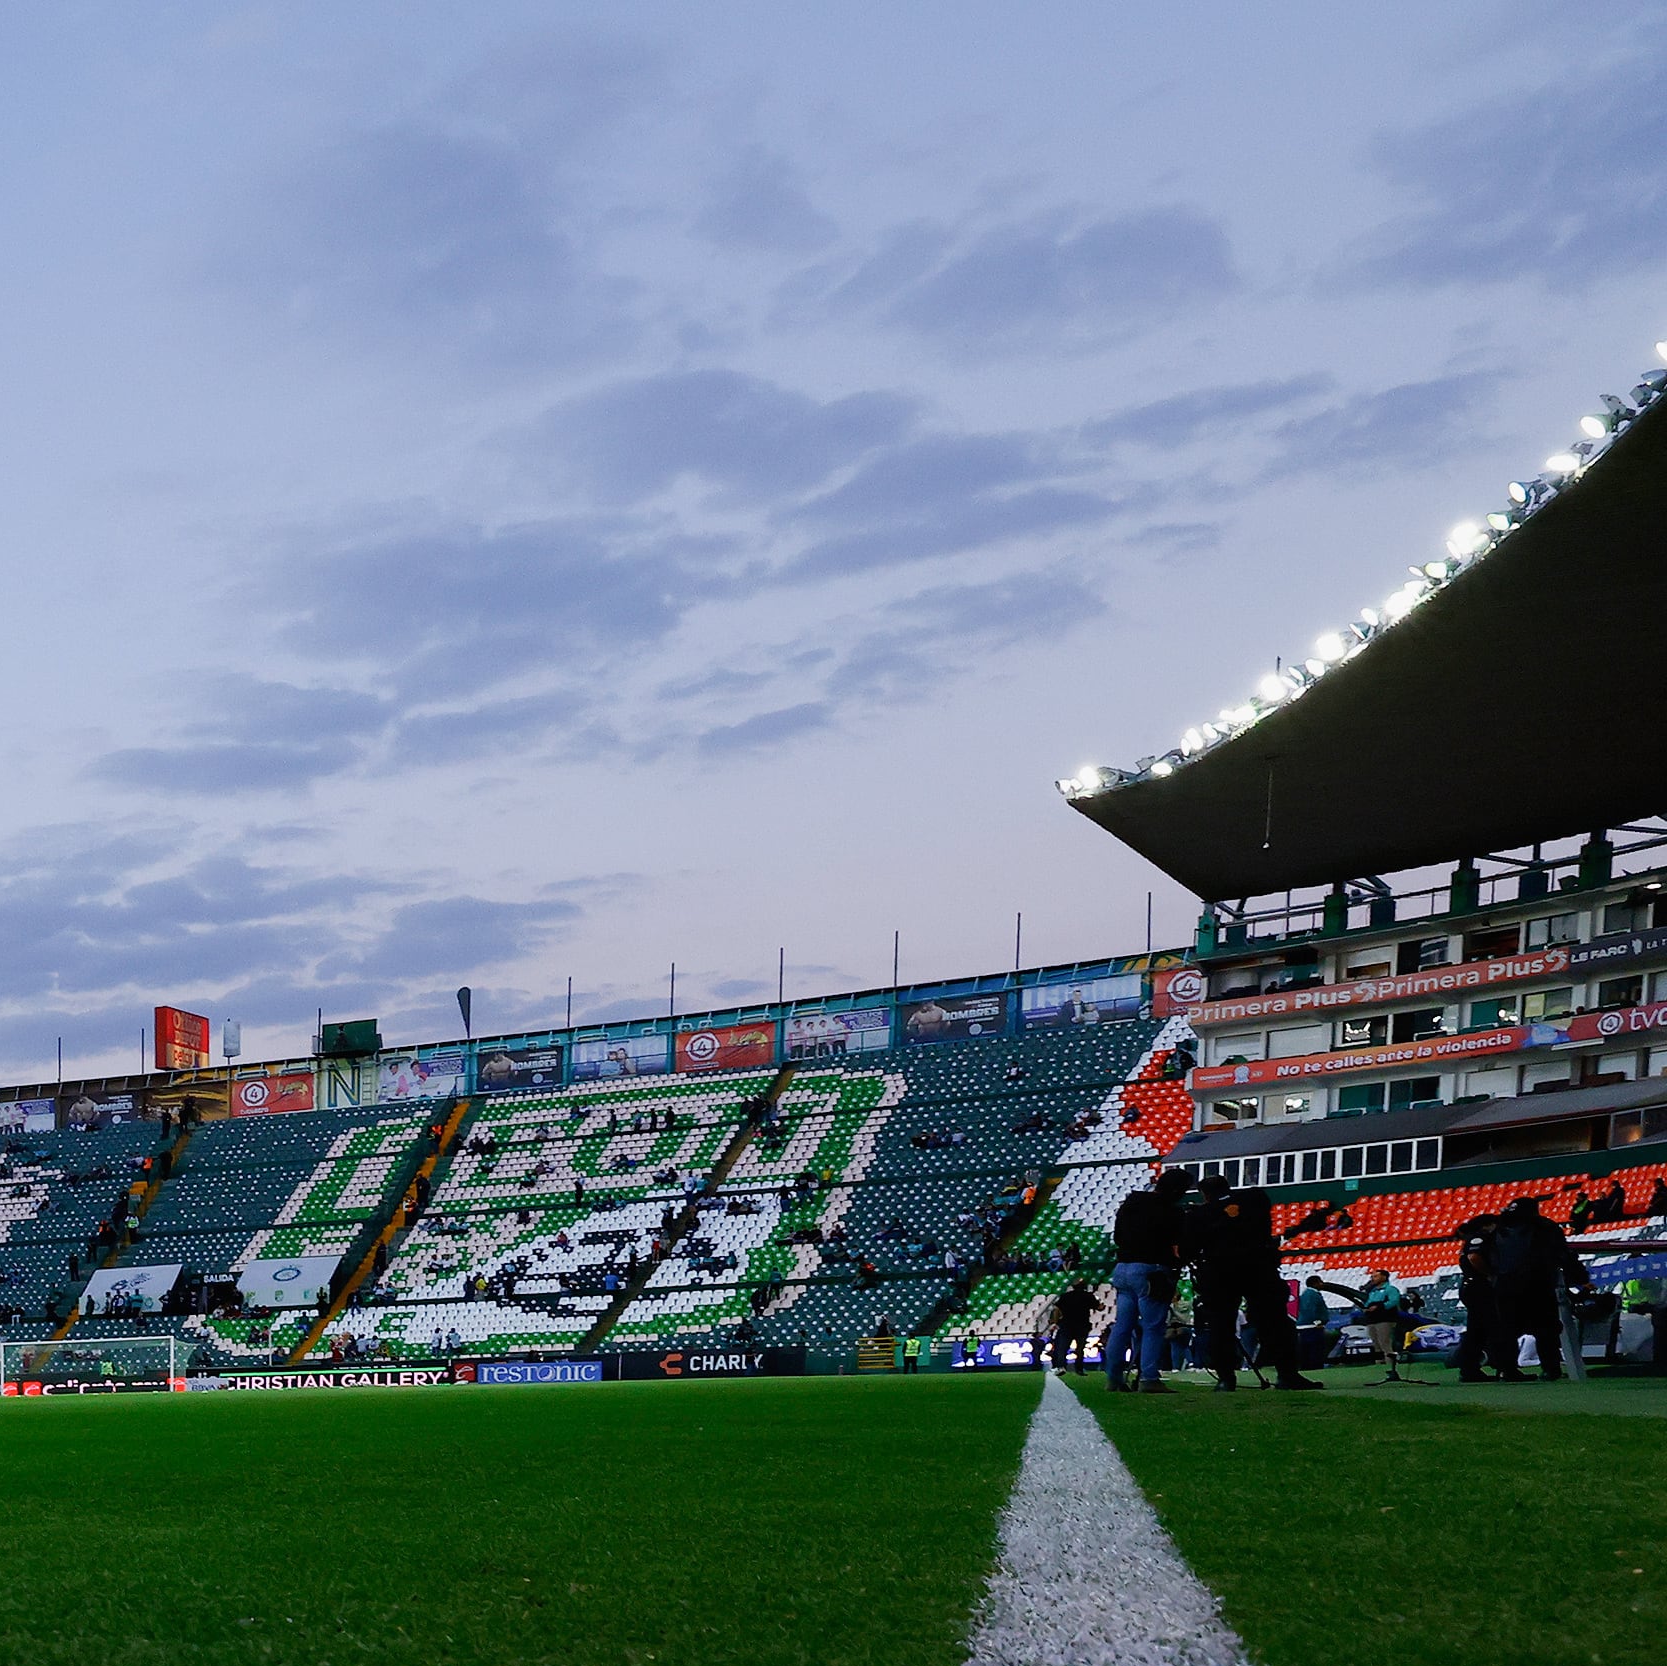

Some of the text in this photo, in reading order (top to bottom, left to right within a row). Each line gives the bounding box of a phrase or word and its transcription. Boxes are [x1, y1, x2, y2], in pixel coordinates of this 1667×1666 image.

[1379, 958, 1544, 998] Primera Plus
[1187, 990, 1352, 1022] Primera Plus
[1277, 1065, 1301, 1077] No
[1304, 1062, 1321, 1074] te
[1324, 1053, 1374, 1072] calles
[1377, 1049, 1413, 1065] ante
[1417, 1045, 1433, 1059] la
[1435, 1033, 1513, 1057] violencia
[203, 1273, 234, 1284] SALIDA
[227, 1374, 337, 1390] CHRISTIAN
